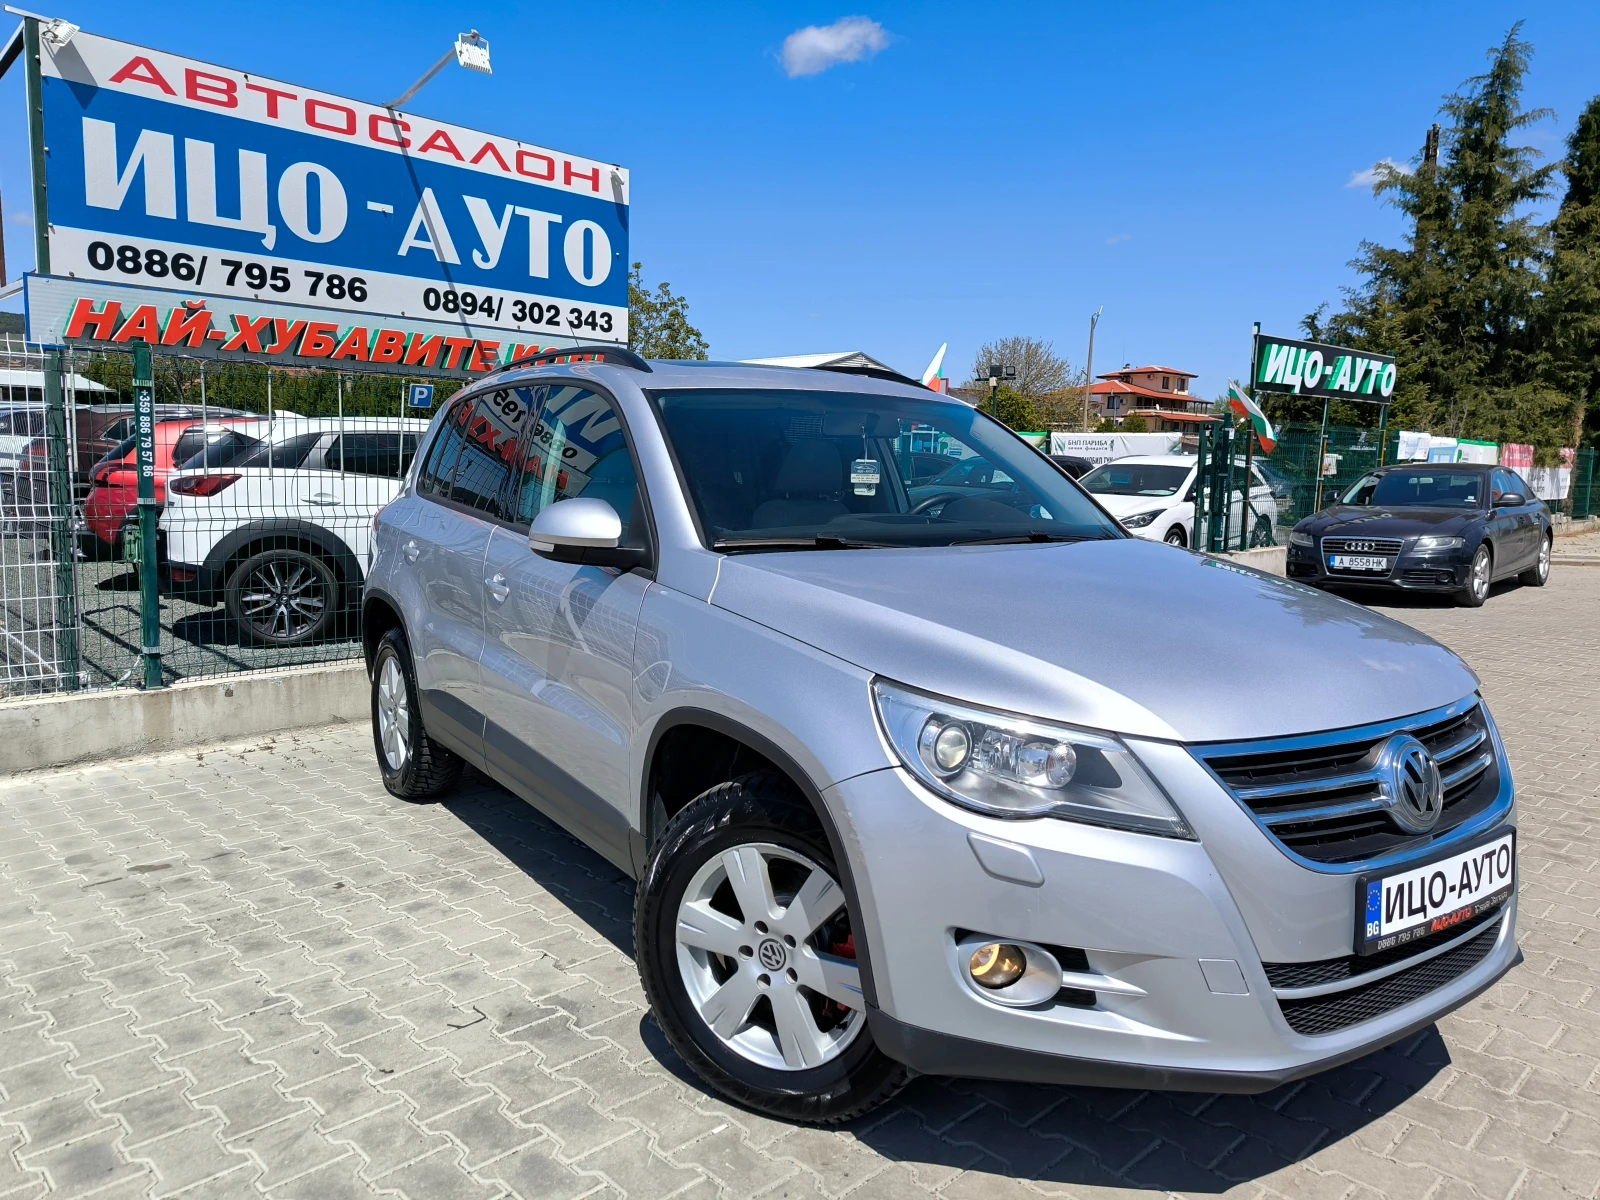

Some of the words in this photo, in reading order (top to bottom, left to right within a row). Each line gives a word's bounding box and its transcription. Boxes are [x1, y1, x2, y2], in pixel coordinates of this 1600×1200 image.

[108, 56, 600, 193] АВТОСАЛОН
[87, 240, 208, 286] 0886/
[220, 258, 291, 294] 795
[303, 270, 367, 303] 786
[423, 286, 503, 322] 0894/
[511, 299, 560, 328] 302
[567, 307, 614, 333] 343
[65, 298, 500, 372] НАЙ-ХУБАВИТЕ
[1259, 343, 1396, 397] ИЦО-АУТО
[139, 389, 150, 413] +359
[140, 416, 151, 434] 886
[140, 436, 152, 448] 79
[142, 451, 153, 463] 57
[143, 465, 154, 477] 86
[1339, 557, 1344, 566] A
[1349, 557, 1371, 567] 8558
[1372, 559, 1384, 568] HK
[1385, 843, 1510, 925] ИЦО-АУТО
[1367, 920, 1379, 937] BG
